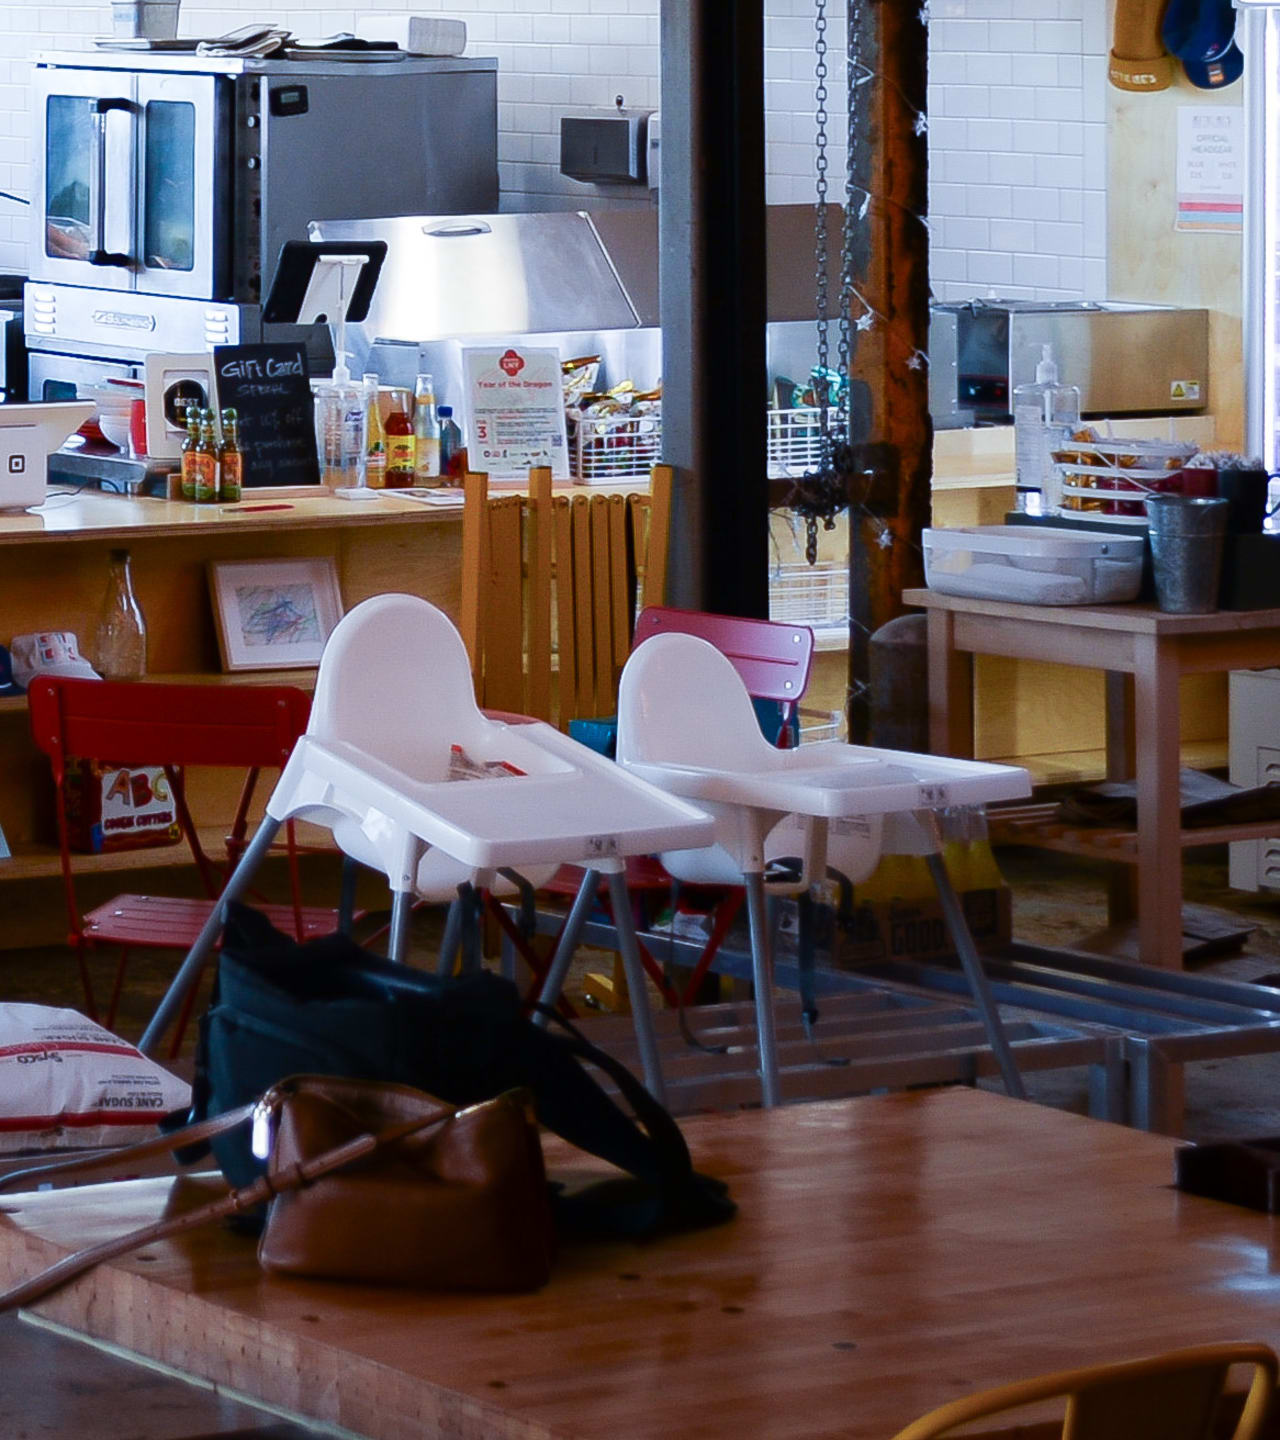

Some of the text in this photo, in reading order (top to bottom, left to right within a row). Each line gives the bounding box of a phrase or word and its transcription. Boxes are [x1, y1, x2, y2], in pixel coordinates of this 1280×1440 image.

[266, 352, 303, 378] Card
[523, 381, 553, 390] Dragon
[477, 426, 487, 438] 3
[106, 768, 170, 808] ABC
[16, 1050, 64, 1065] Sysco
[134, 1095, 164, 1108] CANE
